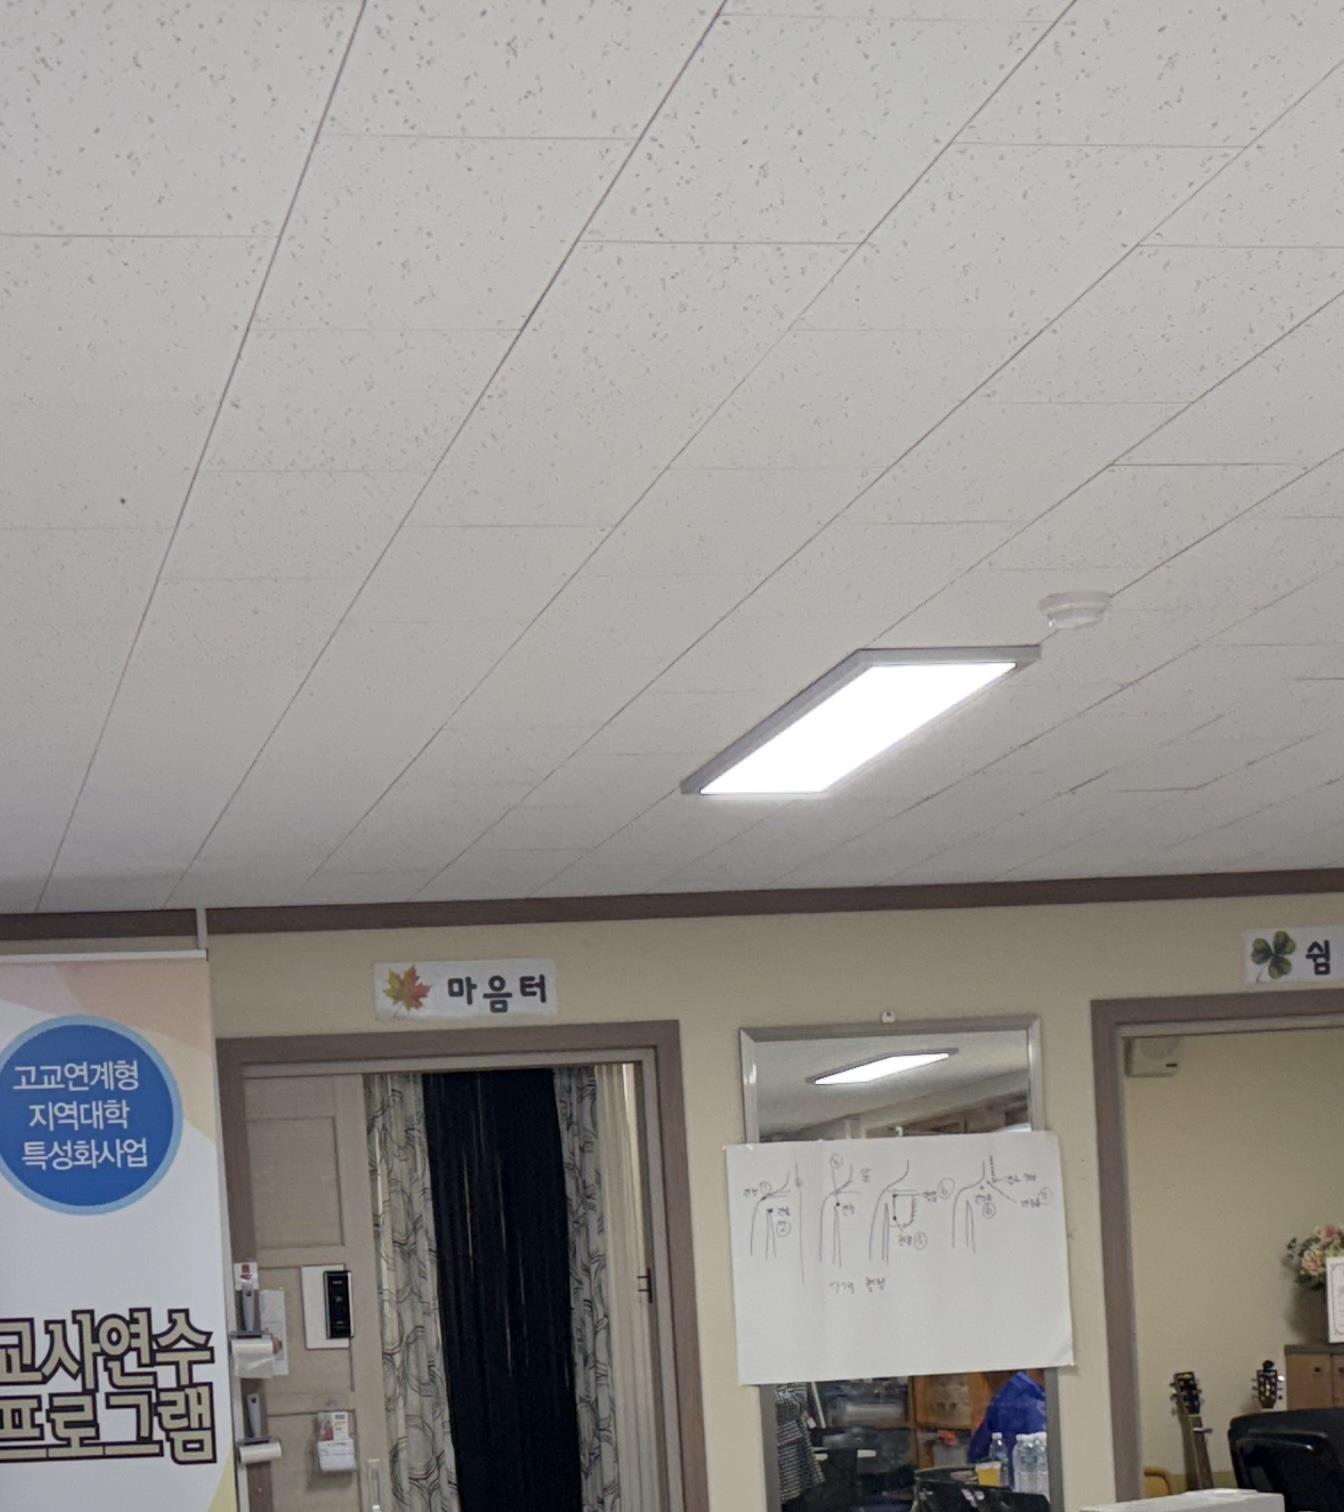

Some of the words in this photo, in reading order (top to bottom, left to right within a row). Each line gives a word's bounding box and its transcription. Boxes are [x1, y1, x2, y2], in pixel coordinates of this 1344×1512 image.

[1306, 939, 1331, 975] 쉼
[447, 974, 547, 1013] 마음터
[13, 1059, 140, 1092] 고교연계형
[29, 1099, 131, 1131] 지역대학
[21, 1137, 149, 1171] 특성화사업
